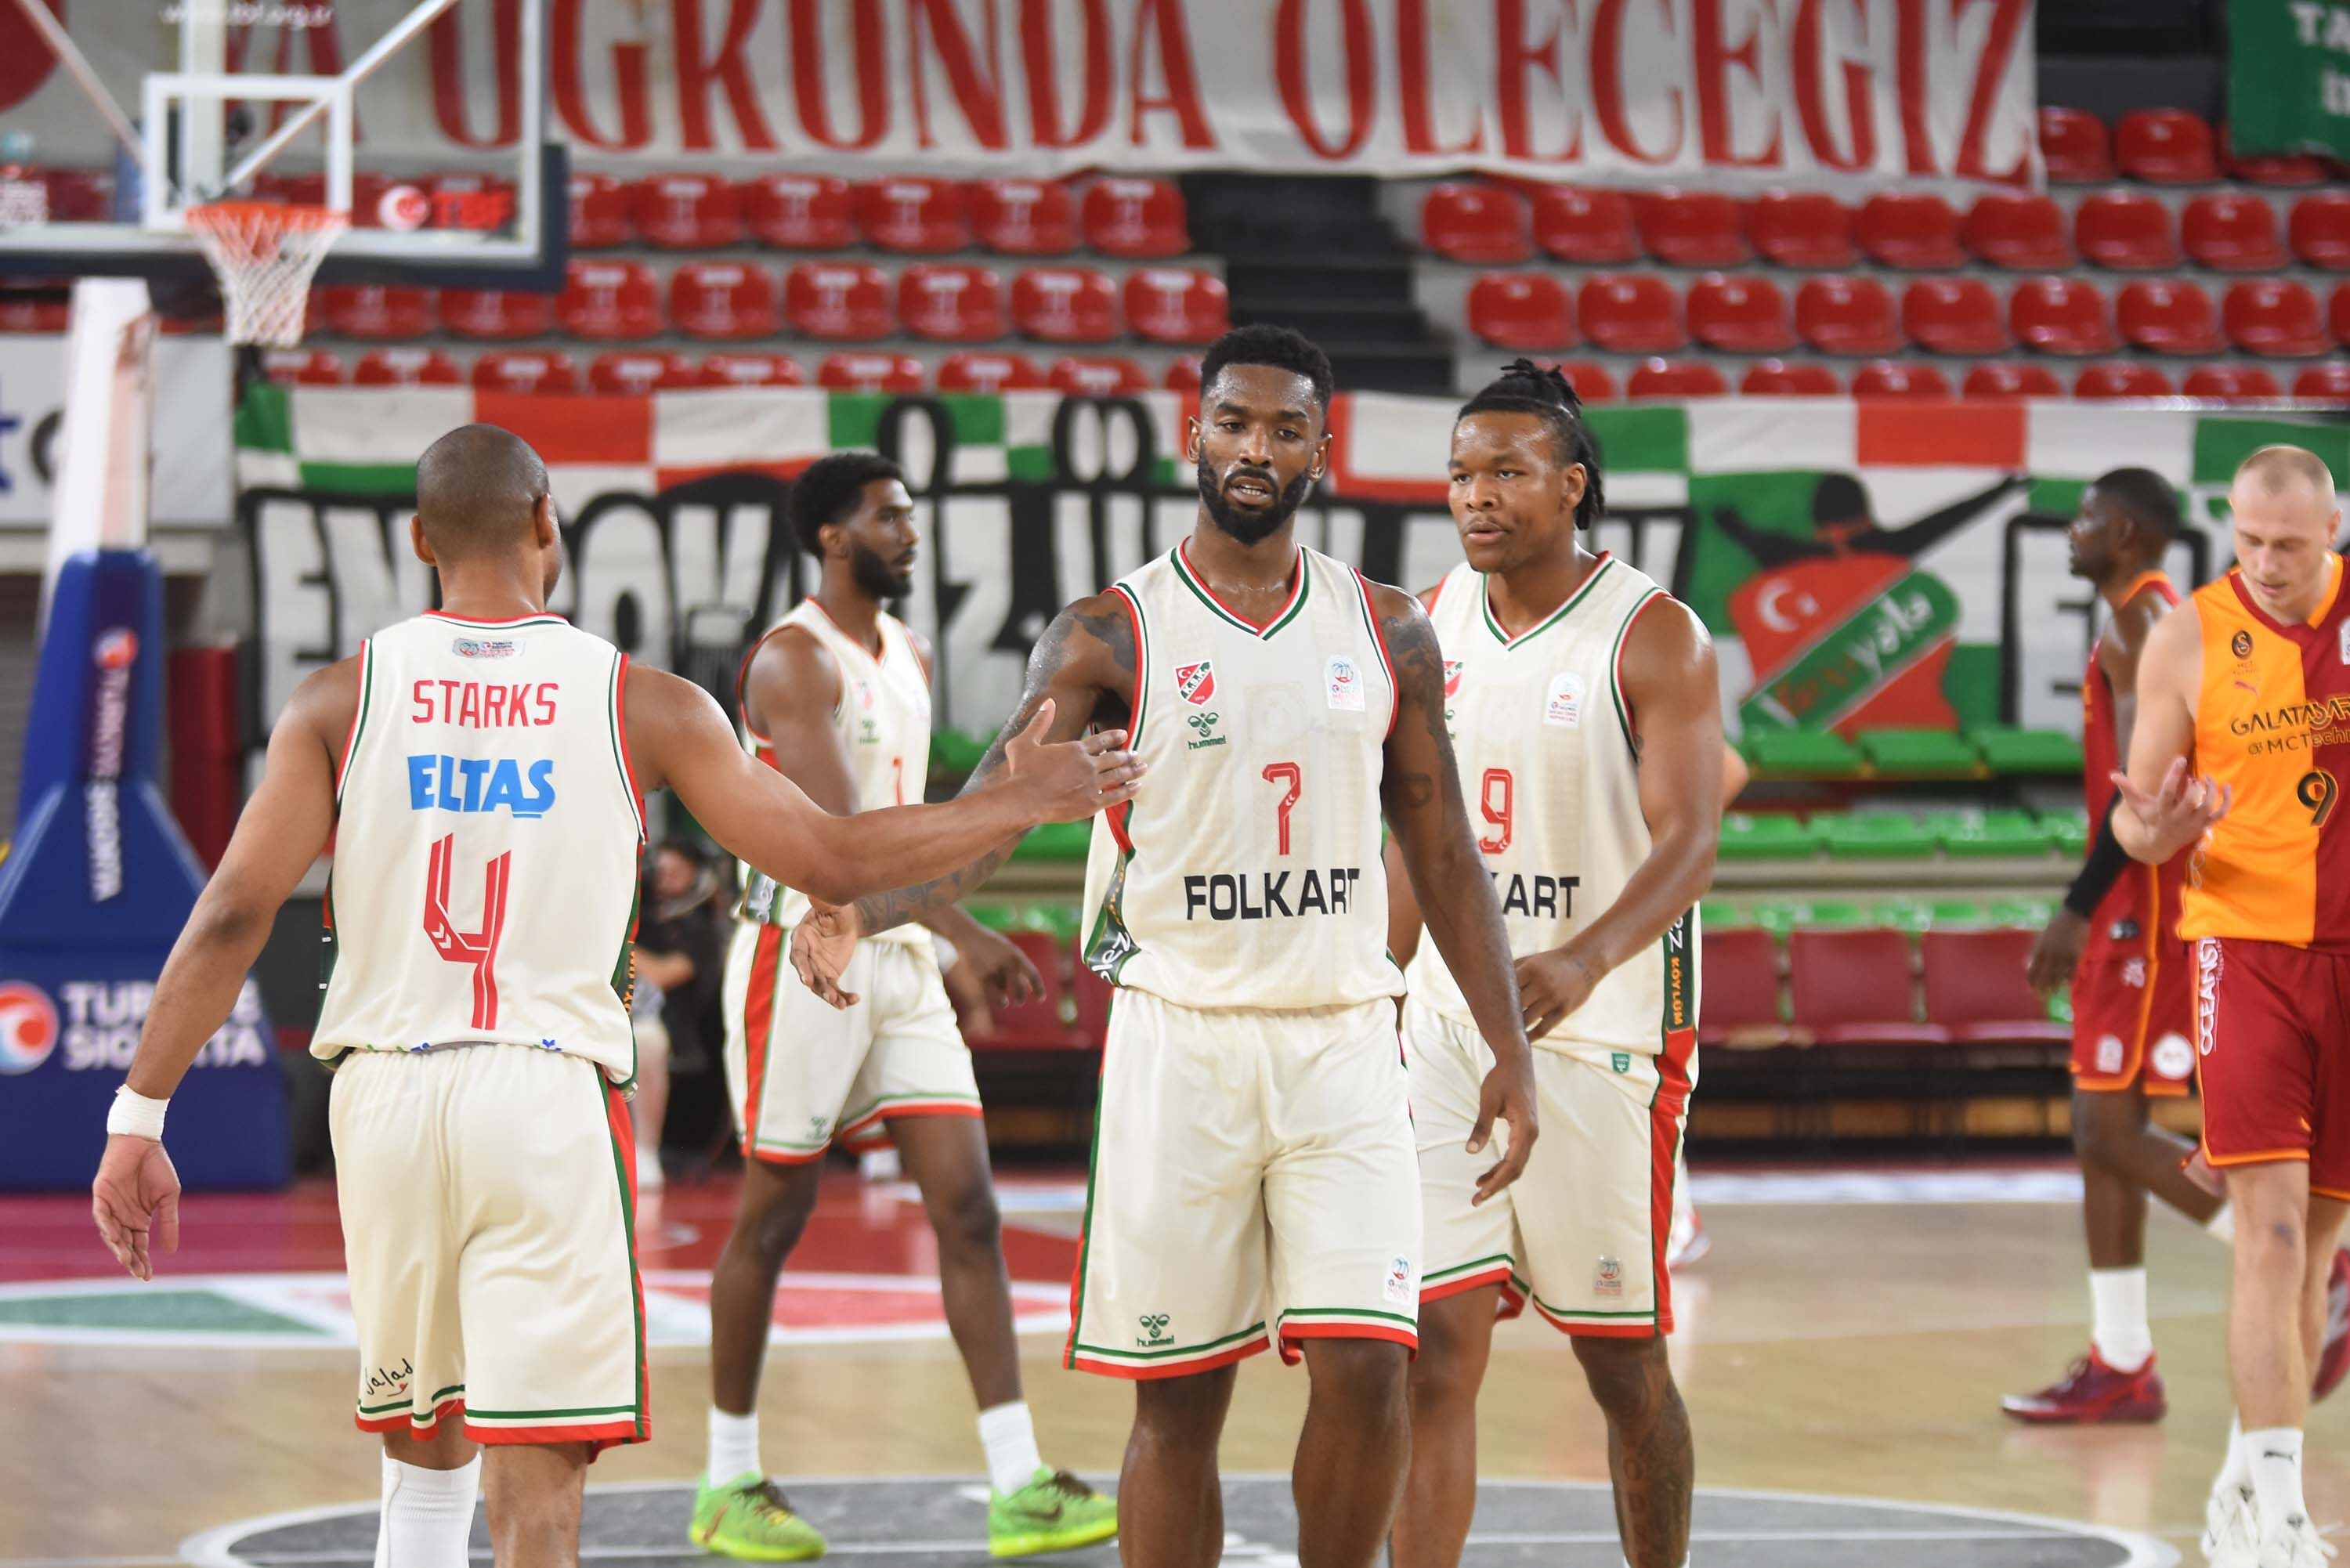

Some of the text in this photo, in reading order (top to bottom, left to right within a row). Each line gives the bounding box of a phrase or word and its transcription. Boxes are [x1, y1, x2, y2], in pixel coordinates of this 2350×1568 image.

[412, 679, 559, 729] STARKS
[1188, 735, 1227, 750] hummel
[1262, 761, 1302, 855] 7
[1478, 768, 1513, 854] 9
[2297, 771, 2339, 828] 9
[1184, 867, 1361, 921] FOLKART
[424, 833, 512, 1031] 4
[1137, 1335, 1174, 1347] hummel
